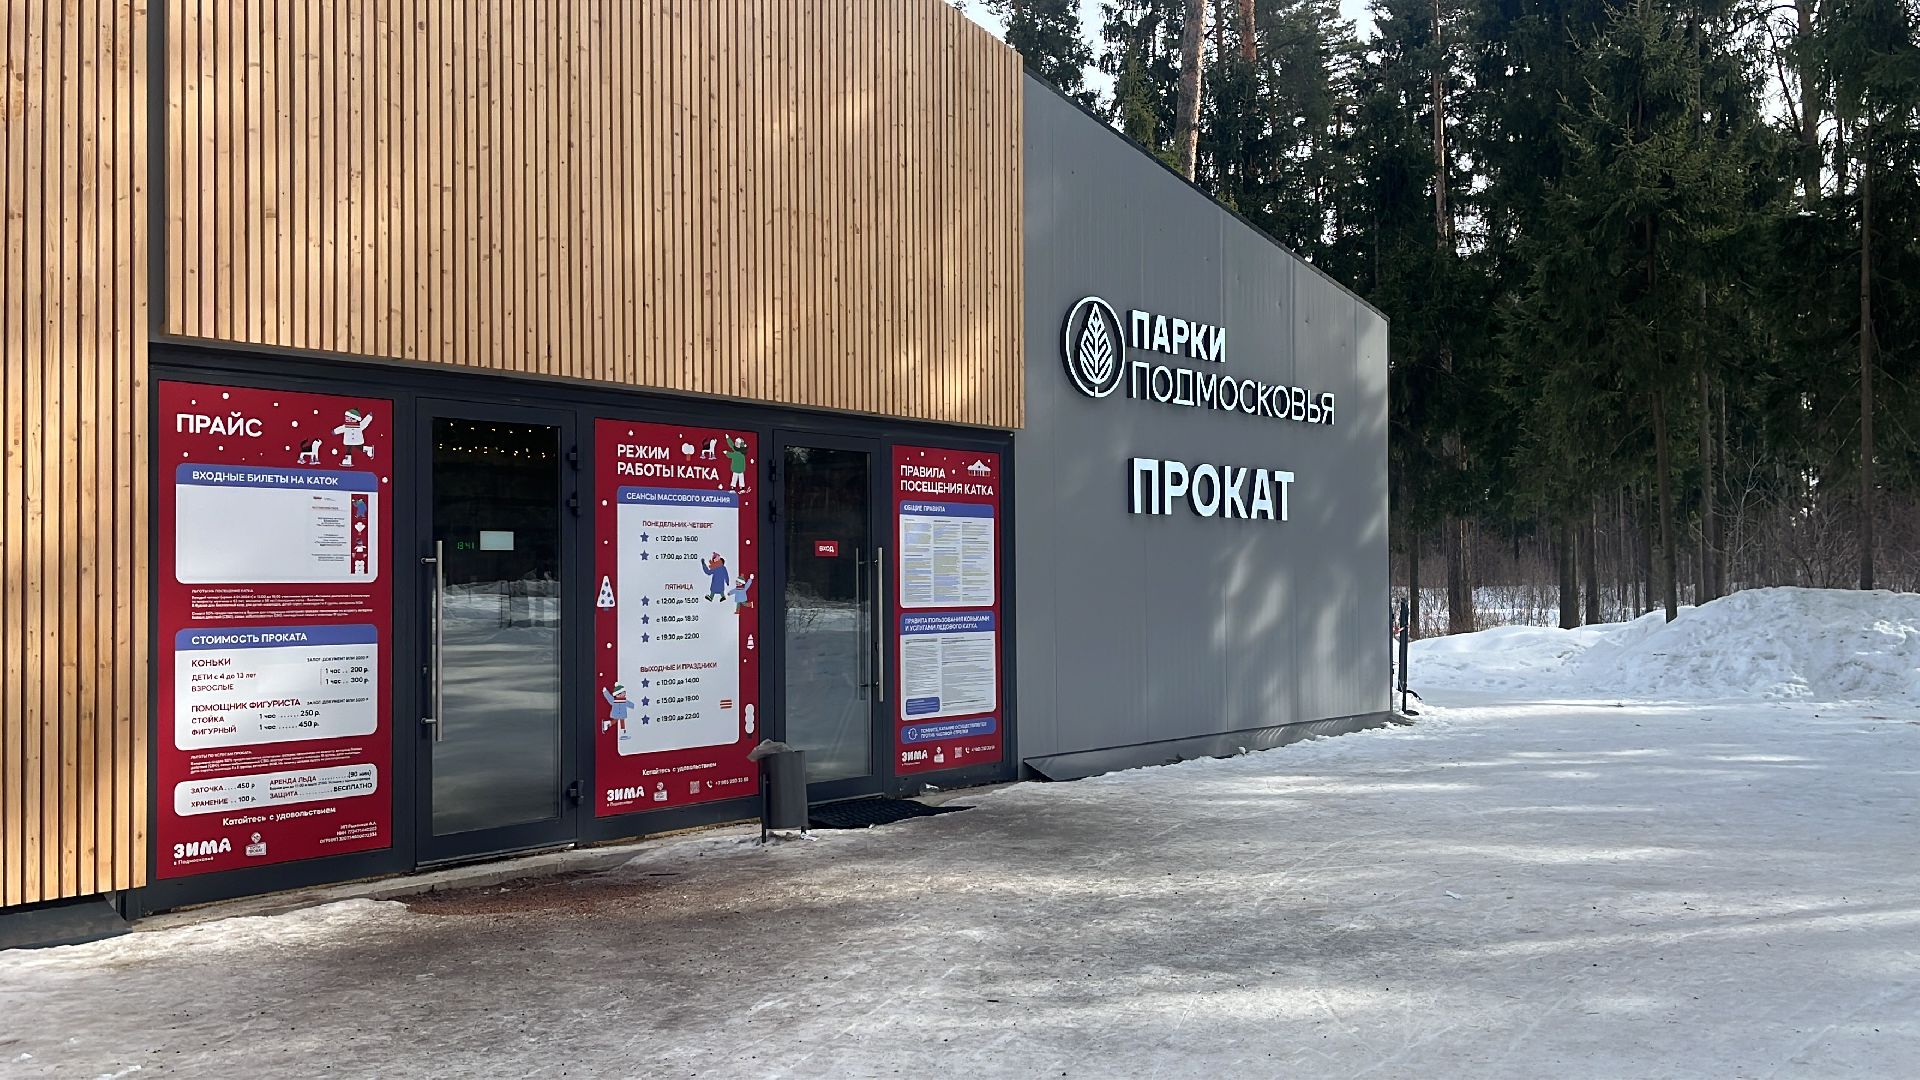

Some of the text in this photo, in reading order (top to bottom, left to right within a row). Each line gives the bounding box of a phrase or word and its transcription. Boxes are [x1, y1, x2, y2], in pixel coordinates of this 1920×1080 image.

[1127, 309, 1226, 362] ПАРКИ
[1127, 361, 1335, 425] ПОДМОСКОВЬЯ
[176, 411, 263, 437] ПРАЙС
[617, 444, 670, 460] РЕЖИМ
[617, 462, 719, 480] РАБОТЫ КАТКА
[900, 465, 945, 478] ПРАВИЛА
[192, 471, 338, 486] ВХОДНЫЕ БИЛЕТЫ НА КАТОК
[900, 480, 993, 496] ПОСЕЩЕНИЯ КАТКА
[1128, 457, 1294, 521] ПРОКАТ
[658, 494, 700, 502] МАССОВОГО
[642, 520, 714, 529] ПОНЕДЕЛЬНИК-ЧЕТВЕРГ
[192, 632, 307, 645] СТОИМОСТЬ ПРОКАТА
[191, 658, 231, 668] КОНЬКИ
[640, 665, 676, 673] ВЫХОДНЫЕ
[682, 662, 717, 670] ПРАЗДНИКИ
[192, 684, 234, 692] ВЗРОСЛЫЕ
[191, 699, 300, 713] ПОМОЩНИК ФИГУРИСТА
[191, 715, 225, 724] СТОЙКА
[191, 725, 236, 736] ФИГУРНЫЙ
[902, 750, 928, 762] ЗИМА
[677, 762, 716, 773] удовольствием
[270, 777, 296, 785] АРЕНДА
[298, 775, 316, 783] ЛЬДА
[191, 784, 223, 795] ЗАТОЧКА
[270, 782, 373, 799] ЗАЩИТА БЕСПЛАТНО
[607, 786, 644, 801] ЗИМА
[191, 798, 229, 807] ХРАНЕНИЕ
[239, 795, 250, 803] 100
[222, 815, 266, 826] Катайтесь
[275, 807, 336, 821] удовольствием
[174, 838, 231, 859] ЗИМА
